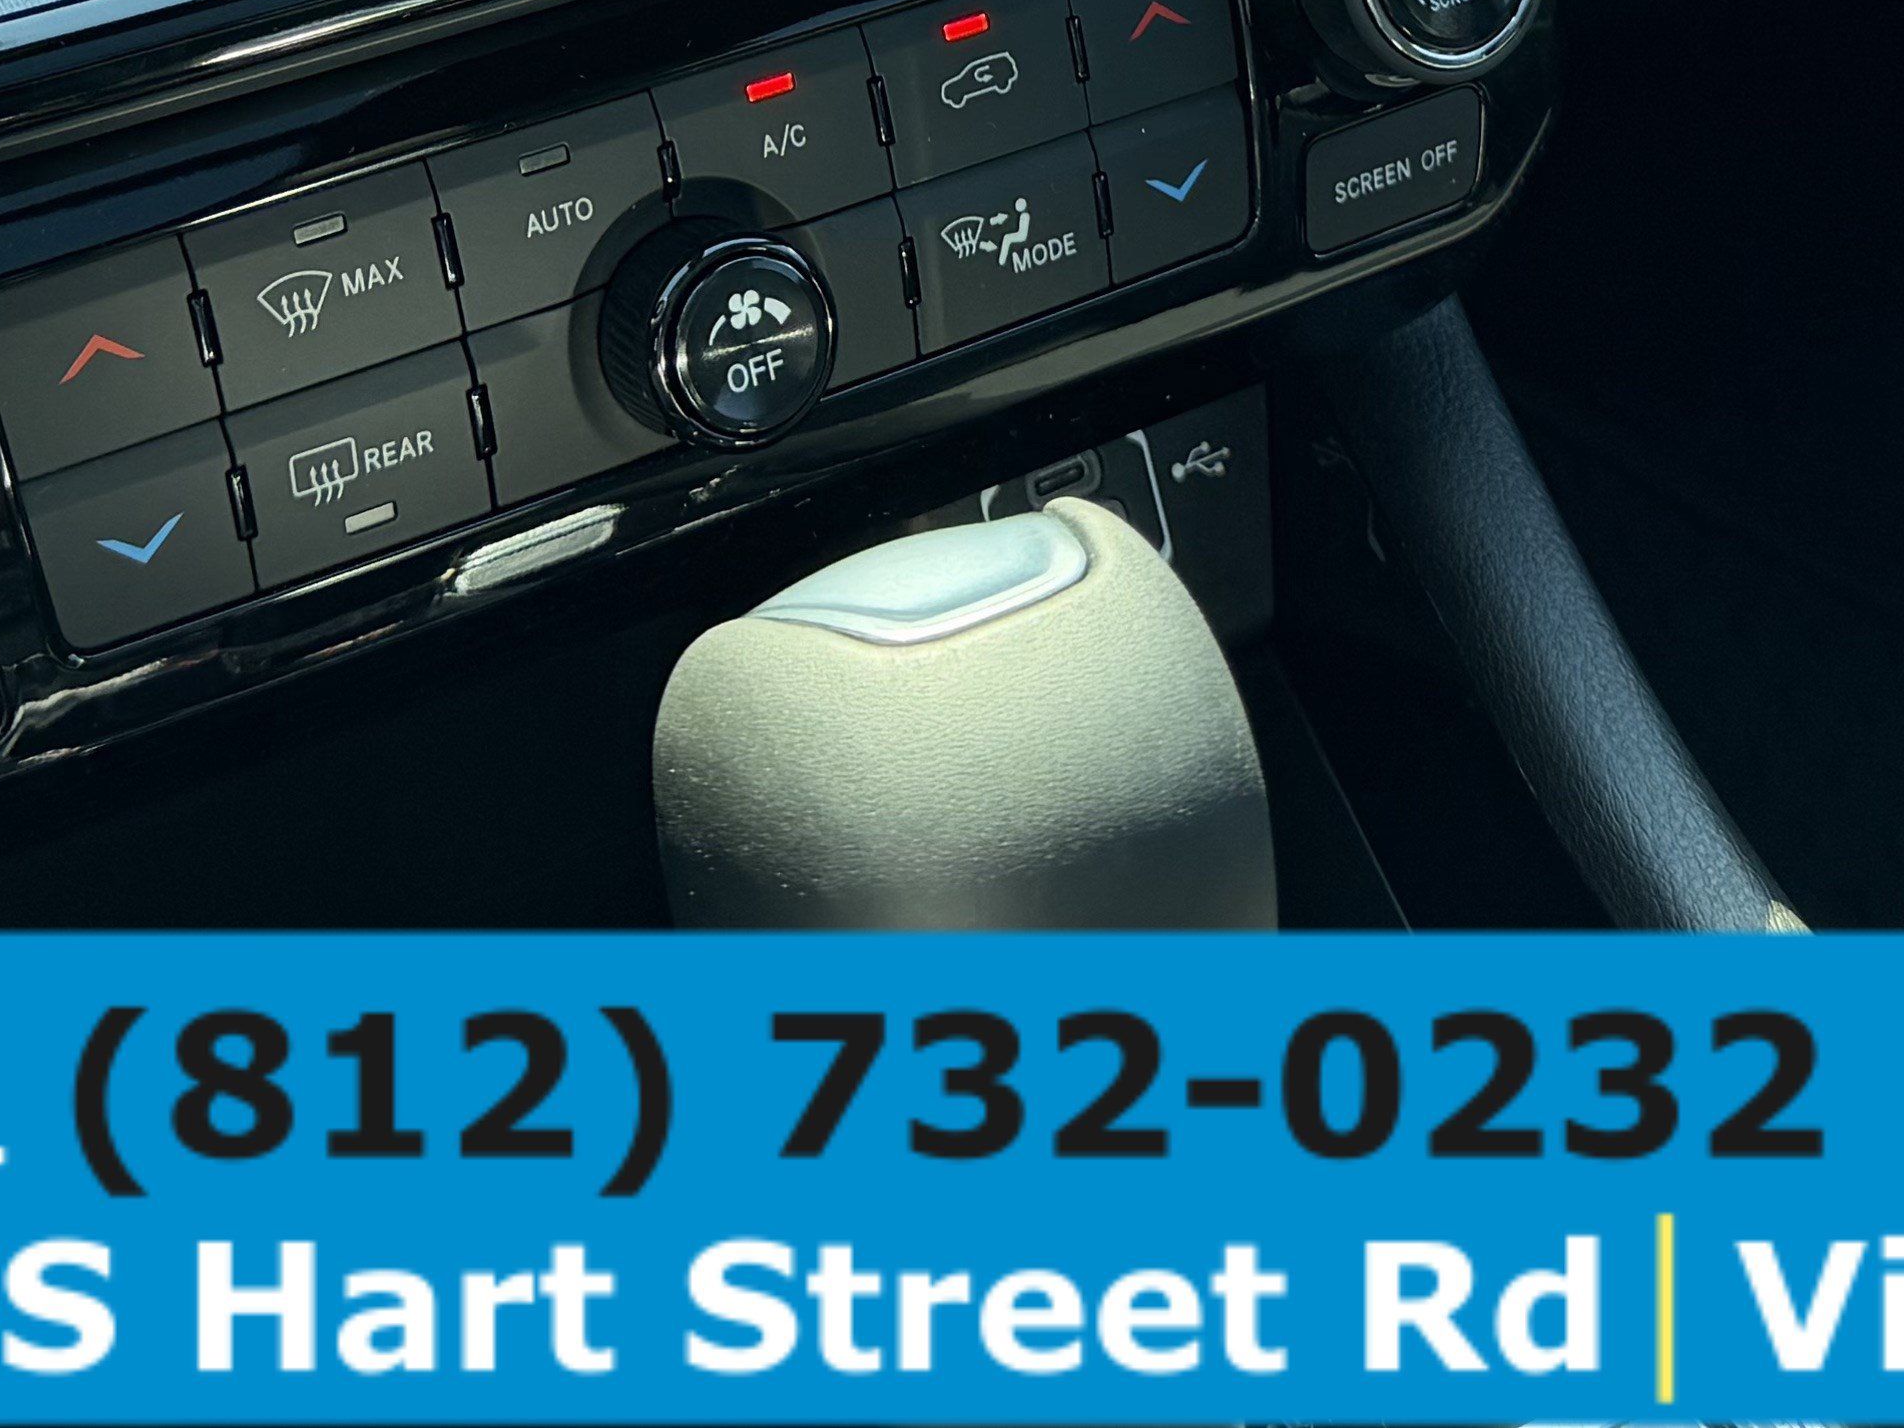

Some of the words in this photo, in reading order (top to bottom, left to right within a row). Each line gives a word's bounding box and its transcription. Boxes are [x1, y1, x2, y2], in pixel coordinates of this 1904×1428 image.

[762, 124, 807, 158] A/C
[1334, 157, 1411, 204] SCREEN
[1421, 139, 1459, 173] OFF
[526, 196, 594, 239] AUTO
[1010, 232, 1077, 274] MODE
[341, 255, 405, 298] MAX
[727, 348, 785, 393] OFF
[363, 429, 434, 474] REAR
